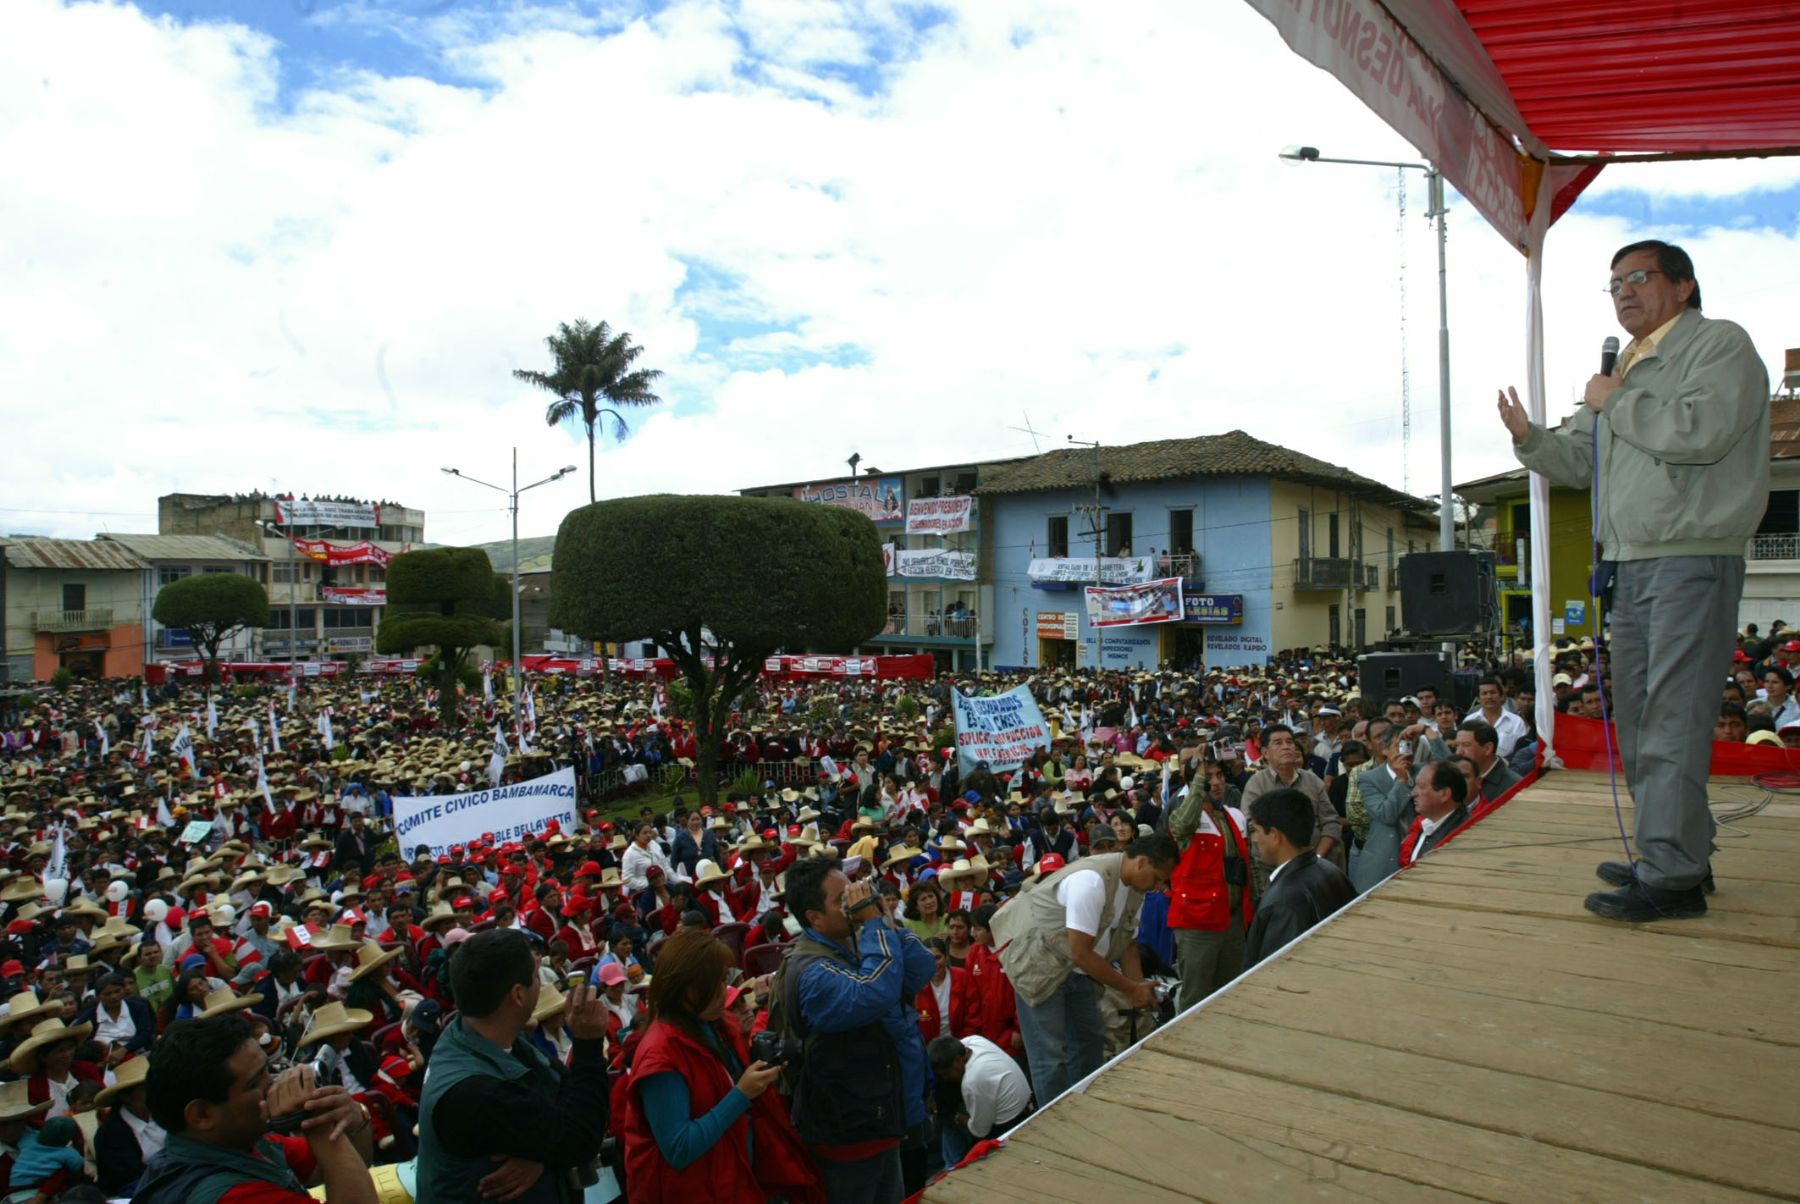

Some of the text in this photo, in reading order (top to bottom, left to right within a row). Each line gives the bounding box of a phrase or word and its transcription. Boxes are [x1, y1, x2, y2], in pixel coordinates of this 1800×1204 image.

[1185, 597, 1214, 606] FOTO
[397, 783, 575, 836] COMITE CIVICO BAMBAMARCA
[514, 811, 573, 837] BELLAVTA
